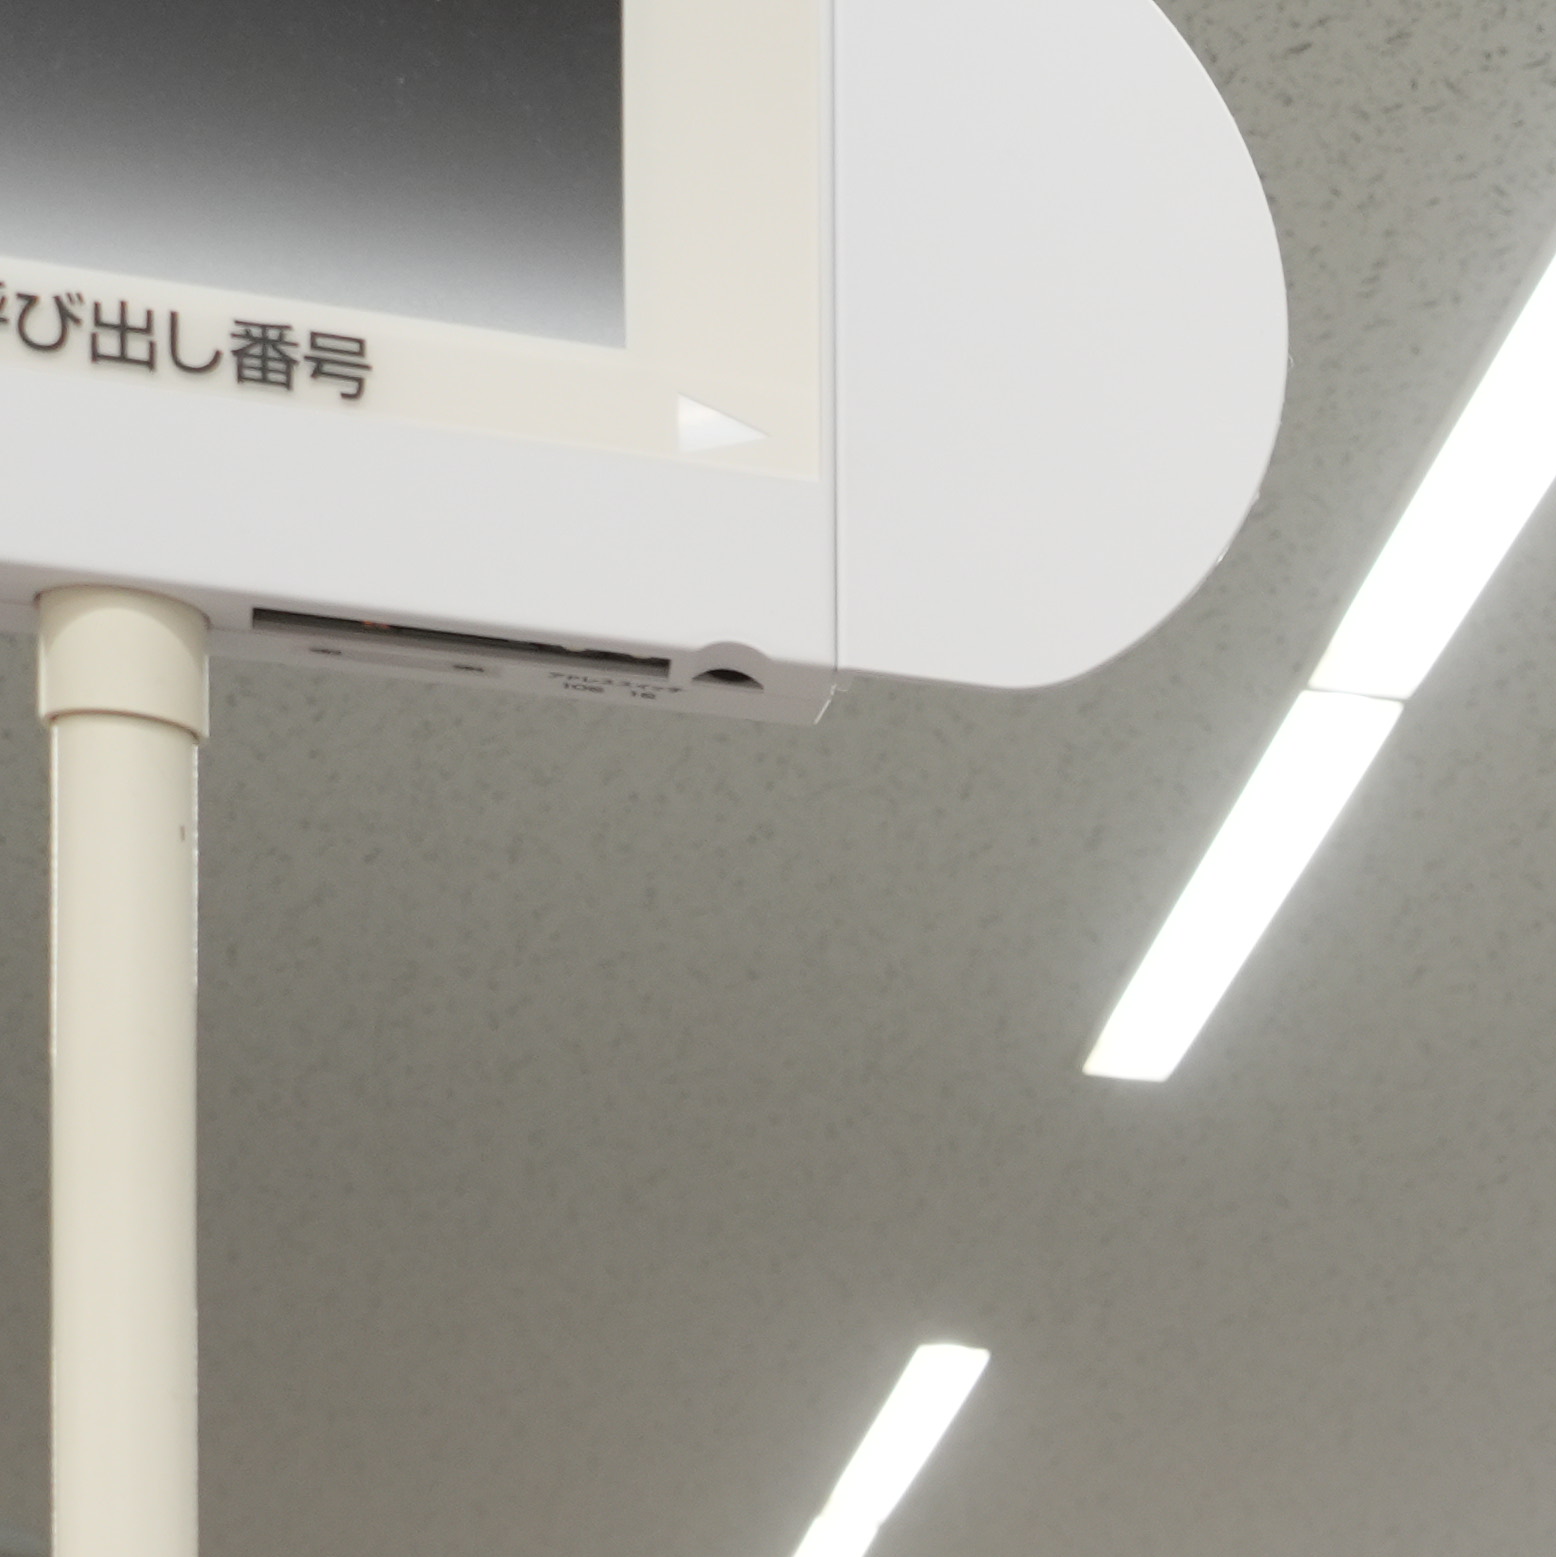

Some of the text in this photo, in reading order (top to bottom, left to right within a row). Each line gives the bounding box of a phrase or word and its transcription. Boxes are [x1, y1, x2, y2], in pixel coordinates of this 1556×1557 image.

[0, 282, 372, 400] び出し番号
